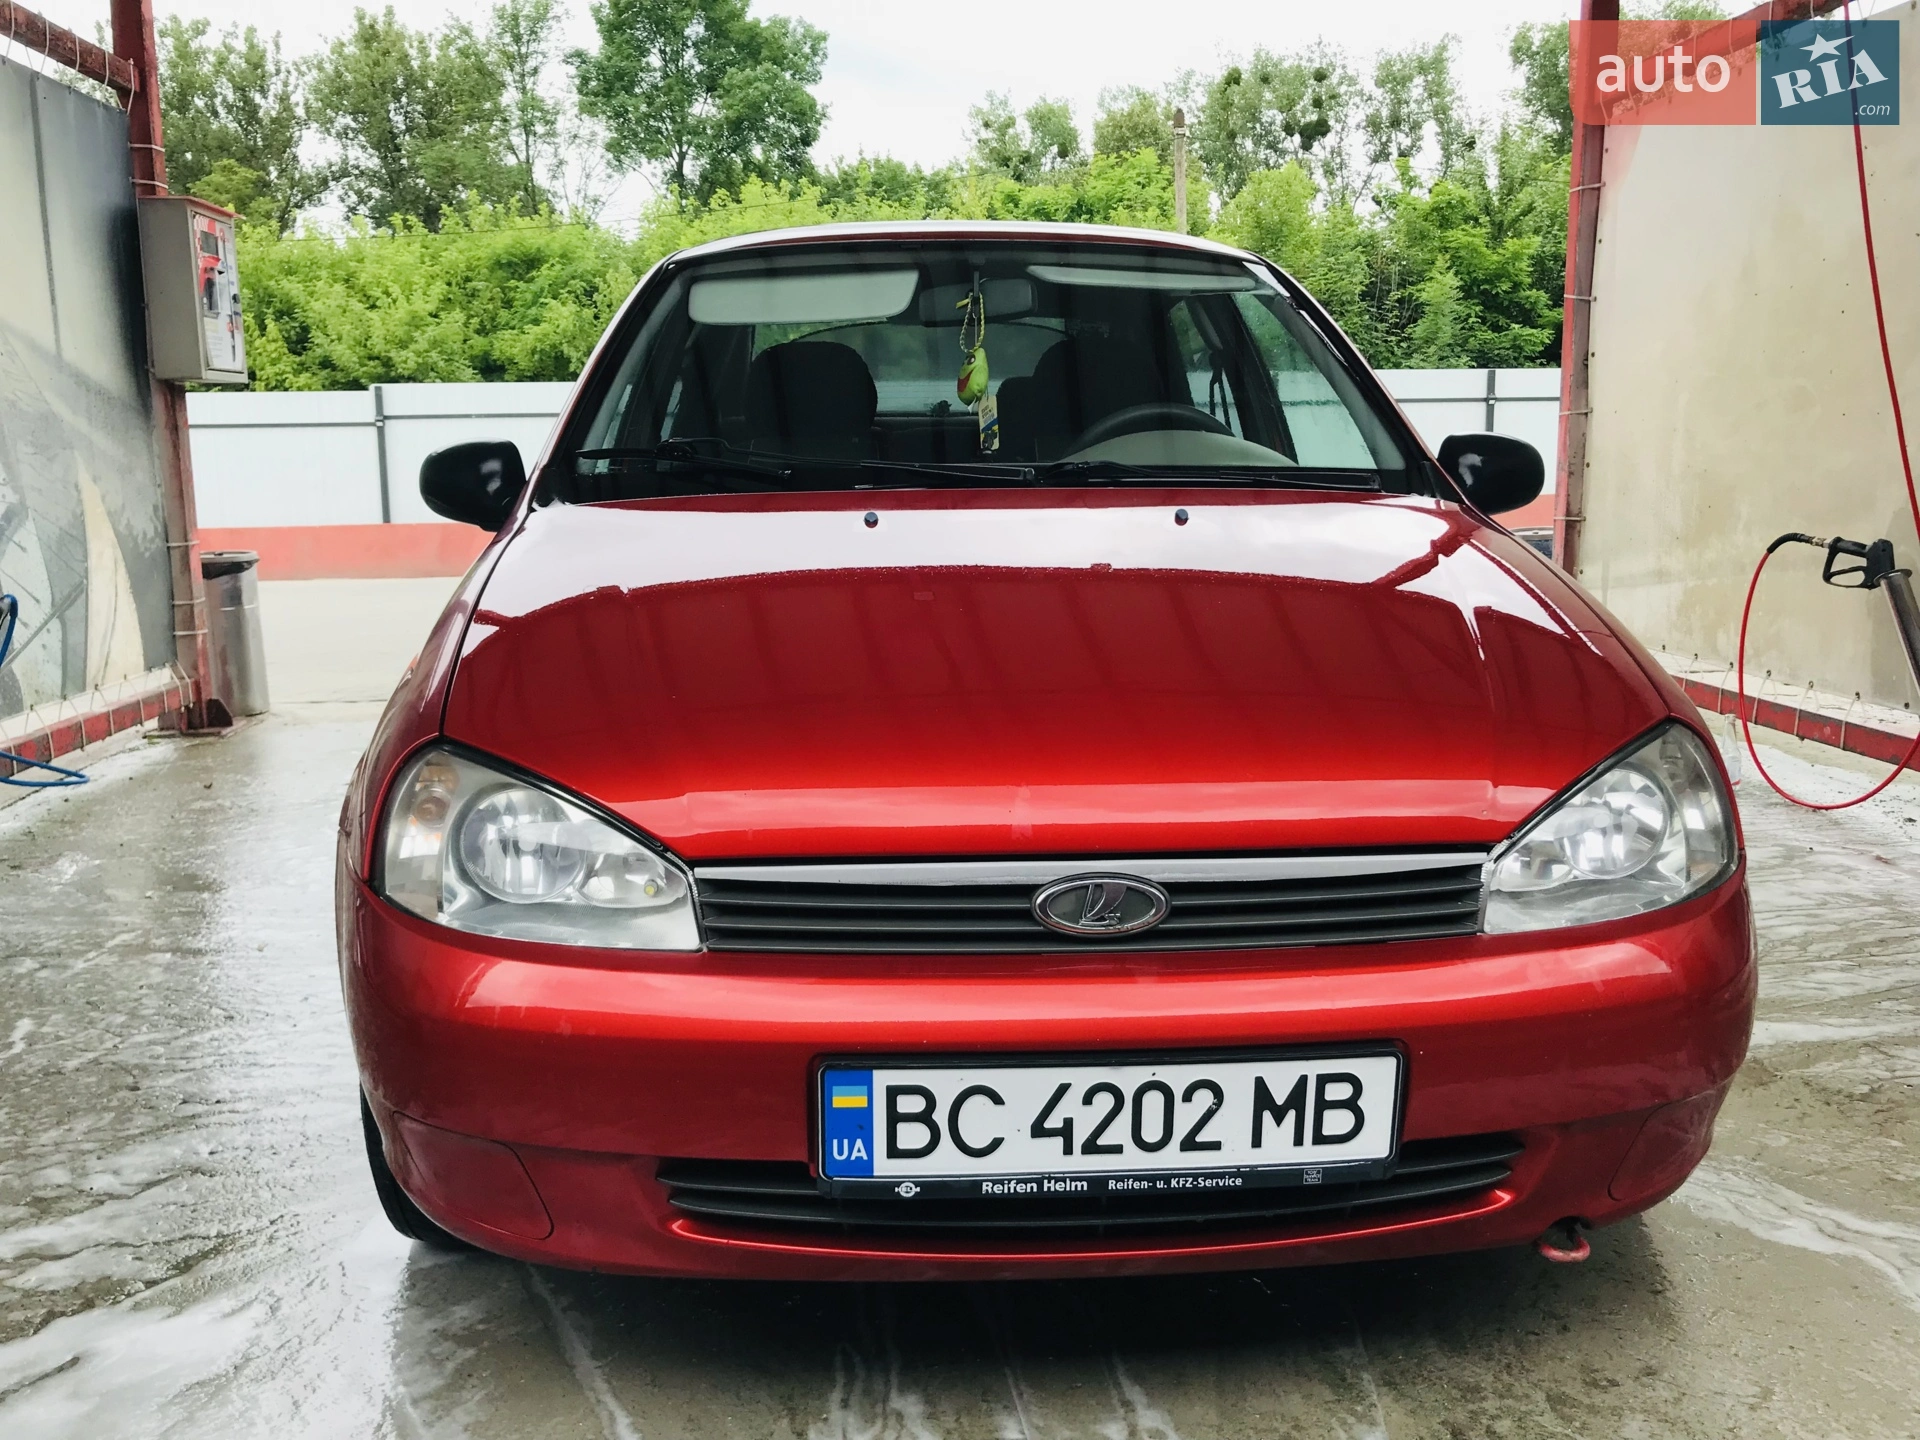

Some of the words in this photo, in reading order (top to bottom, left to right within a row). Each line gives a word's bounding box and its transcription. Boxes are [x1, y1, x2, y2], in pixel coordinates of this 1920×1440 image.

[886, 1084, 1006, 1159] BC
[1030, 1078, 1224, 1155] 4202
[1251, 1072, 1365, 1149] MB
[832, 1138, 868, 1161] UA
[981, 1180, 1038, 1194] Reifen
[1043, 1178, 1088, 1192] Helm
[1108, 1178, 1153, 1190] Reifen-
[1156, 1180, 1168, 1188] u.
[1170, 1175, 1242, 1188] KFZ-Service
